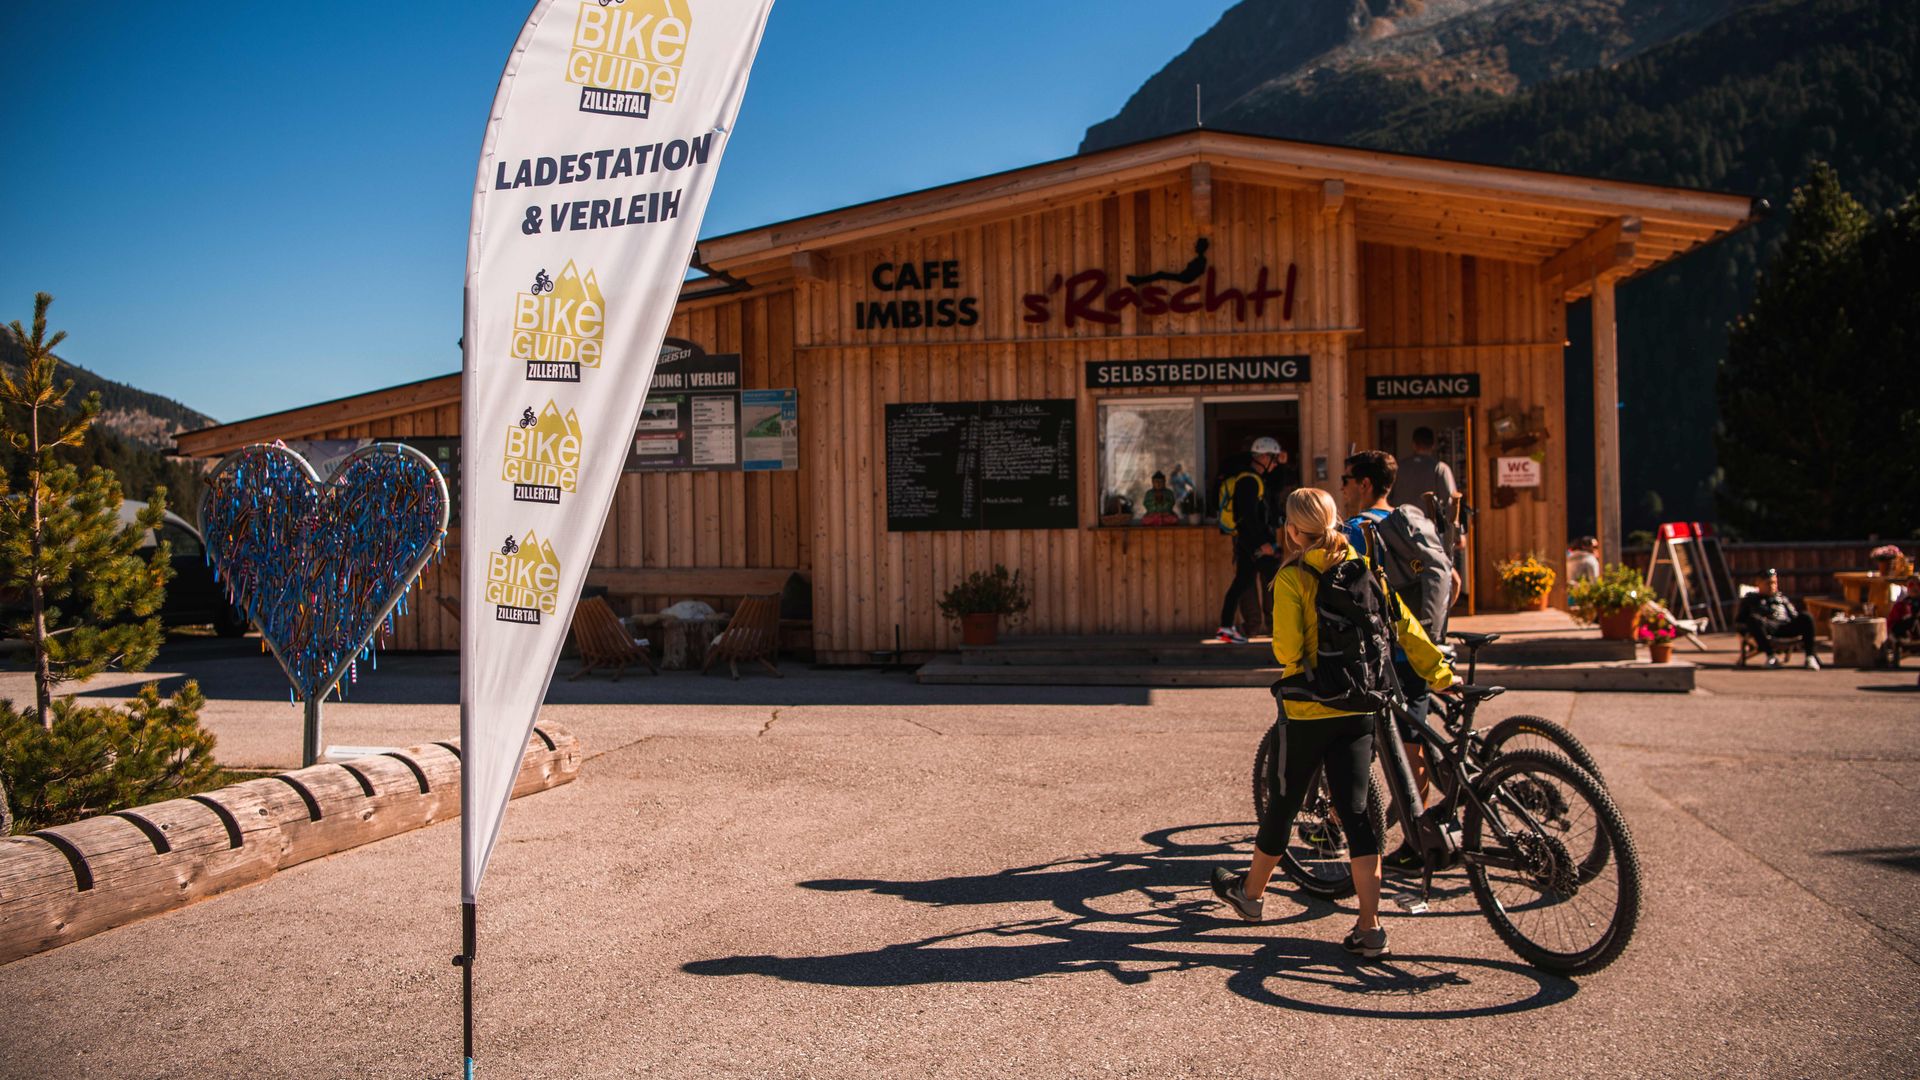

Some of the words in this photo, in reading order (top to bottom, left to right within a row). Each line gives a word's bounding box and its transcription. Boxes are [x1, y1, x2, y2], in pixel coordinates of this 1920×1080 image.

[582, 91, 646, 115] ZILLERTAL
[495, 133, 712, 190] LADESTATION
[521, 205, 543, 235] &
[551, 189, 682, 232] VERLEIH
[872, 260, 959, 291] CAFE
[856, 297, 979, 330] IMBISS
[528, 363, 578, 379] ZILLERTAL
[651, 373, 681, 388] DUNG
[690, 372, 735, 387] VERLEIH
[1098, 361, 1298, 383] SELBSTBEDIENUNG
[1376, 378, 1470, 396] EINGANG
[1507, 461, 1530, 472] WC
[515, 486, 559, 501] ZILLERTAL
[498, 607, 538, 622] ZILLERTAL
